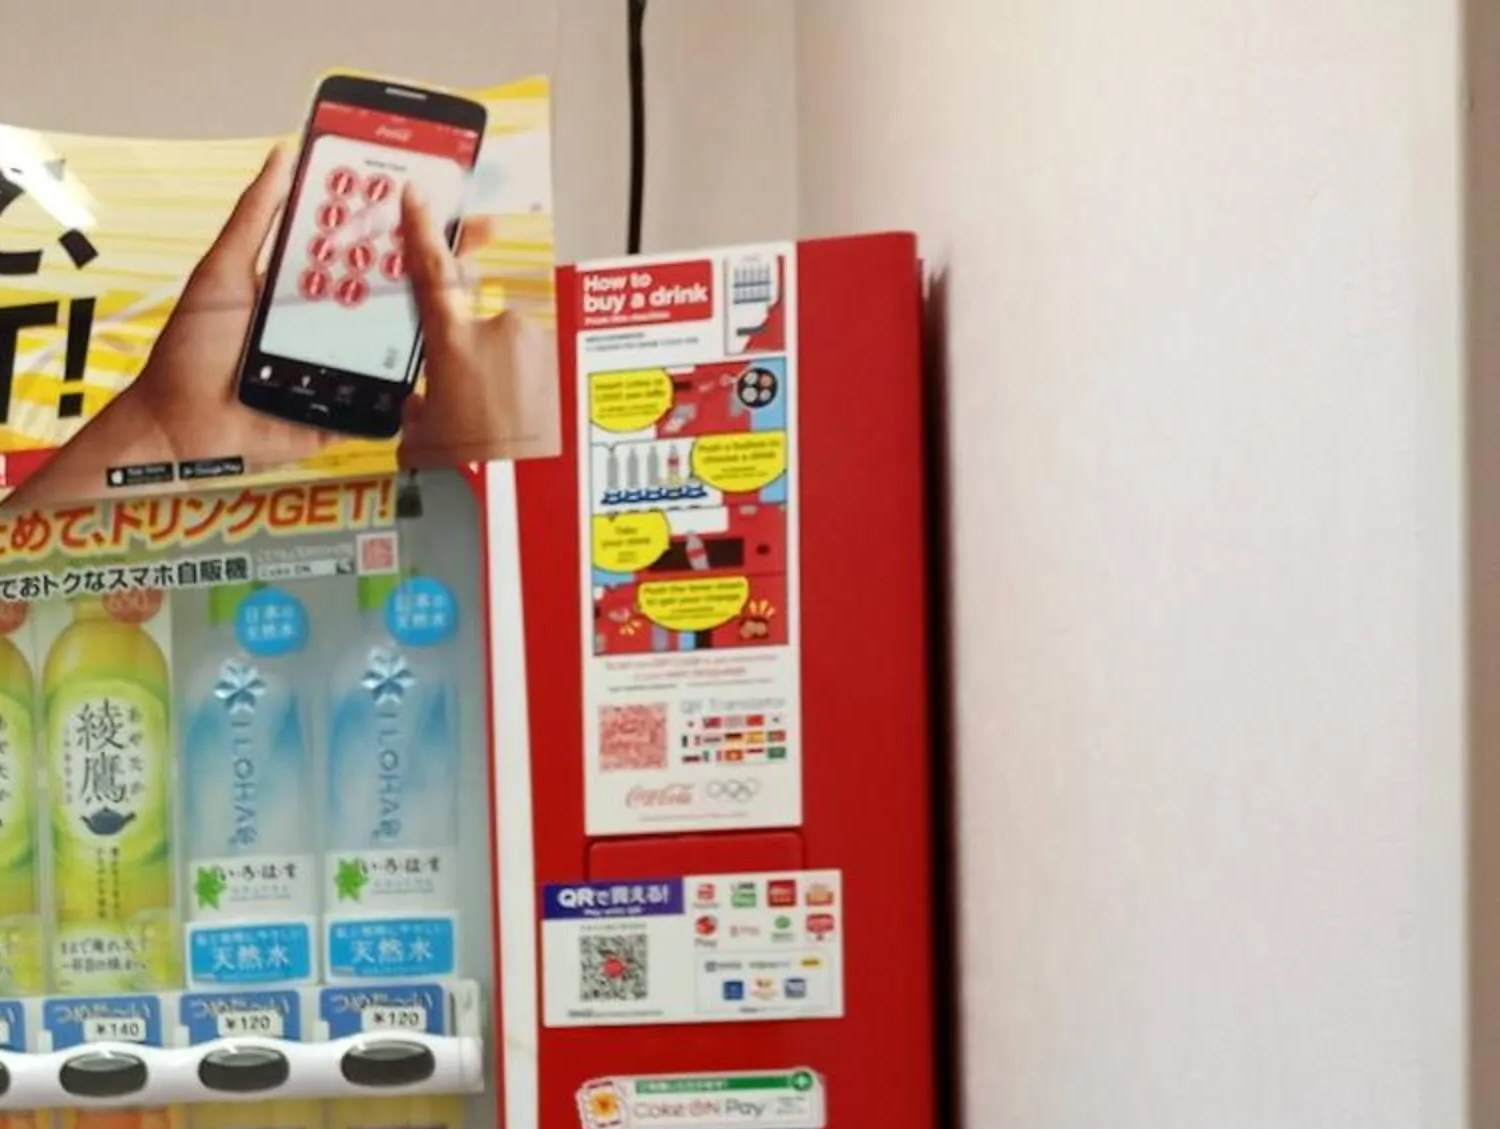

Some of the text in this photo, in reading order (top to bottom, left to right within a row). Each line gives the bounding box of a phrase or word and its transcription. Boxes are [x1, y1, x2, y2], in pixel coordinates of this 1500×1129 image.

[583, 272, 652, 292] How to
[583, 282, 708, 314] buy a drink
[77, 697, 127, 804] 綾鷹
[212, 943, 291, 971] 天然水
[351, 935, 433, 965] 天然水
[634, 1101, 687, 1119] Coke
[725, 1098, 765, 1119] Pay
